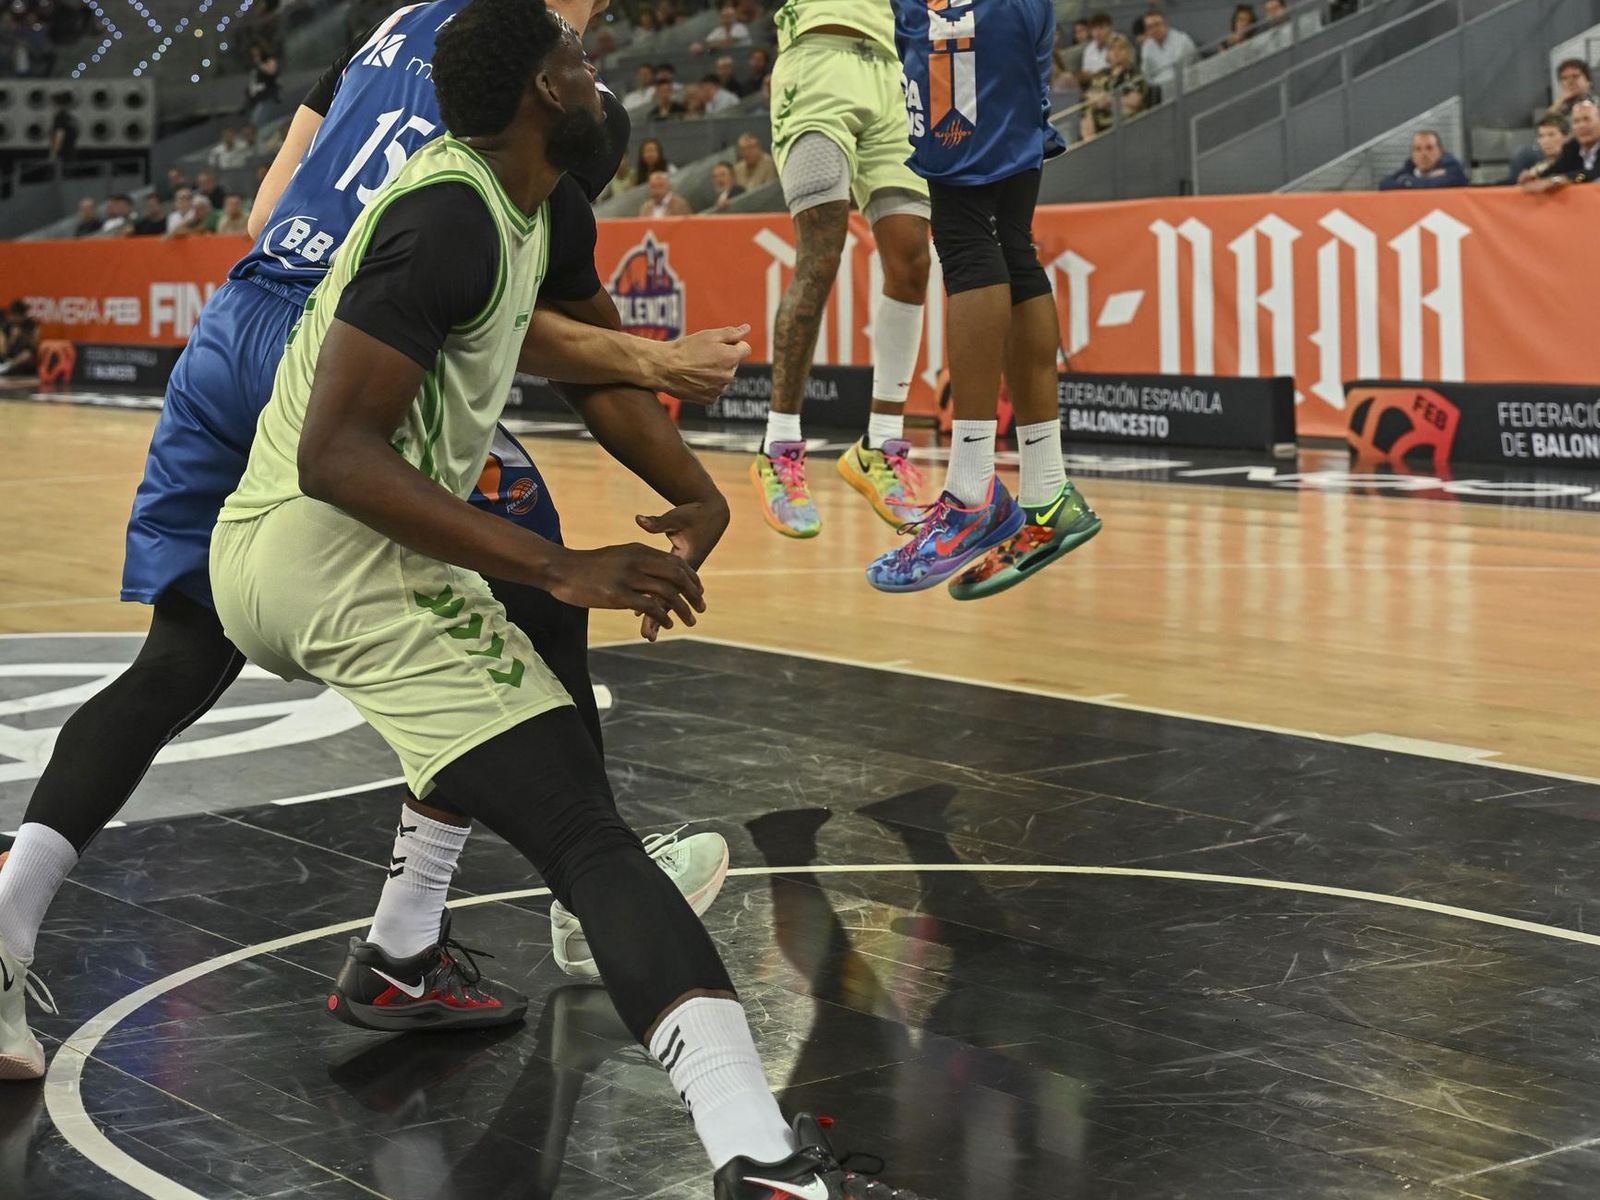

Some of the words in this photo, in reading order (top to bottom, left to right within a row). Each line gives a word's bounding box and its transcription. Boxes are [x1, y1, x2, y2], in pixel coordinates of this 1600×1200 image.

[334, 106, 436, 206] 15
[1058, 381, 1138, 408] EDERACIÓN
[1141, 385, 1223, 415] ESPAÑOLA
[1413, 393, 1449, 431] FEB
[1069, 408, 1169, 438] BALONCESTO
[1501, 432, 1528, 457] DE
